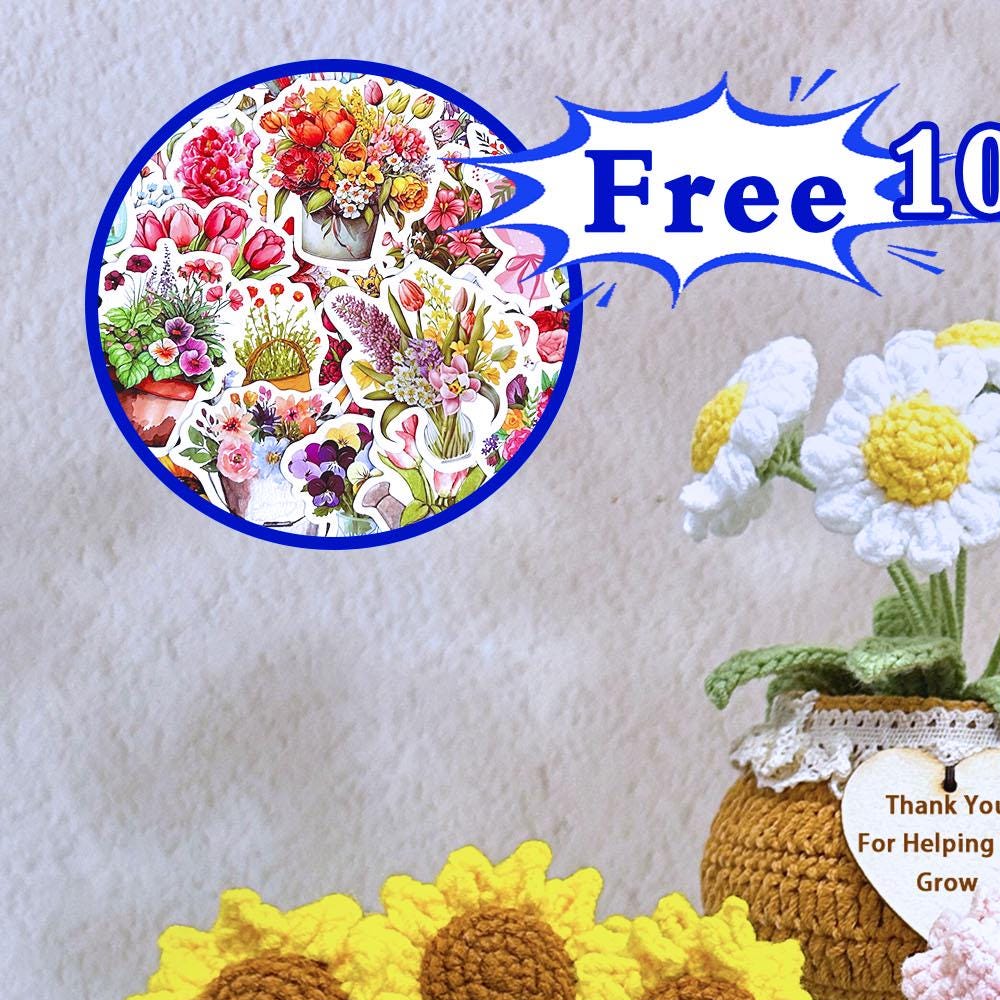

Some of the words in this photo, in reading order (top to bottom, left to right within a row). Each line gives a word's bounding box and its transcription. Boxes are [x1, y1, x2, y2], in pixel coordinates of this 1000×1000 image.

[885, 795, 957, 815] Thank
[858, 833, 896, 853] For
[903, 832, 994, 858] Helping
[916, 872, 979, 892] Grow
